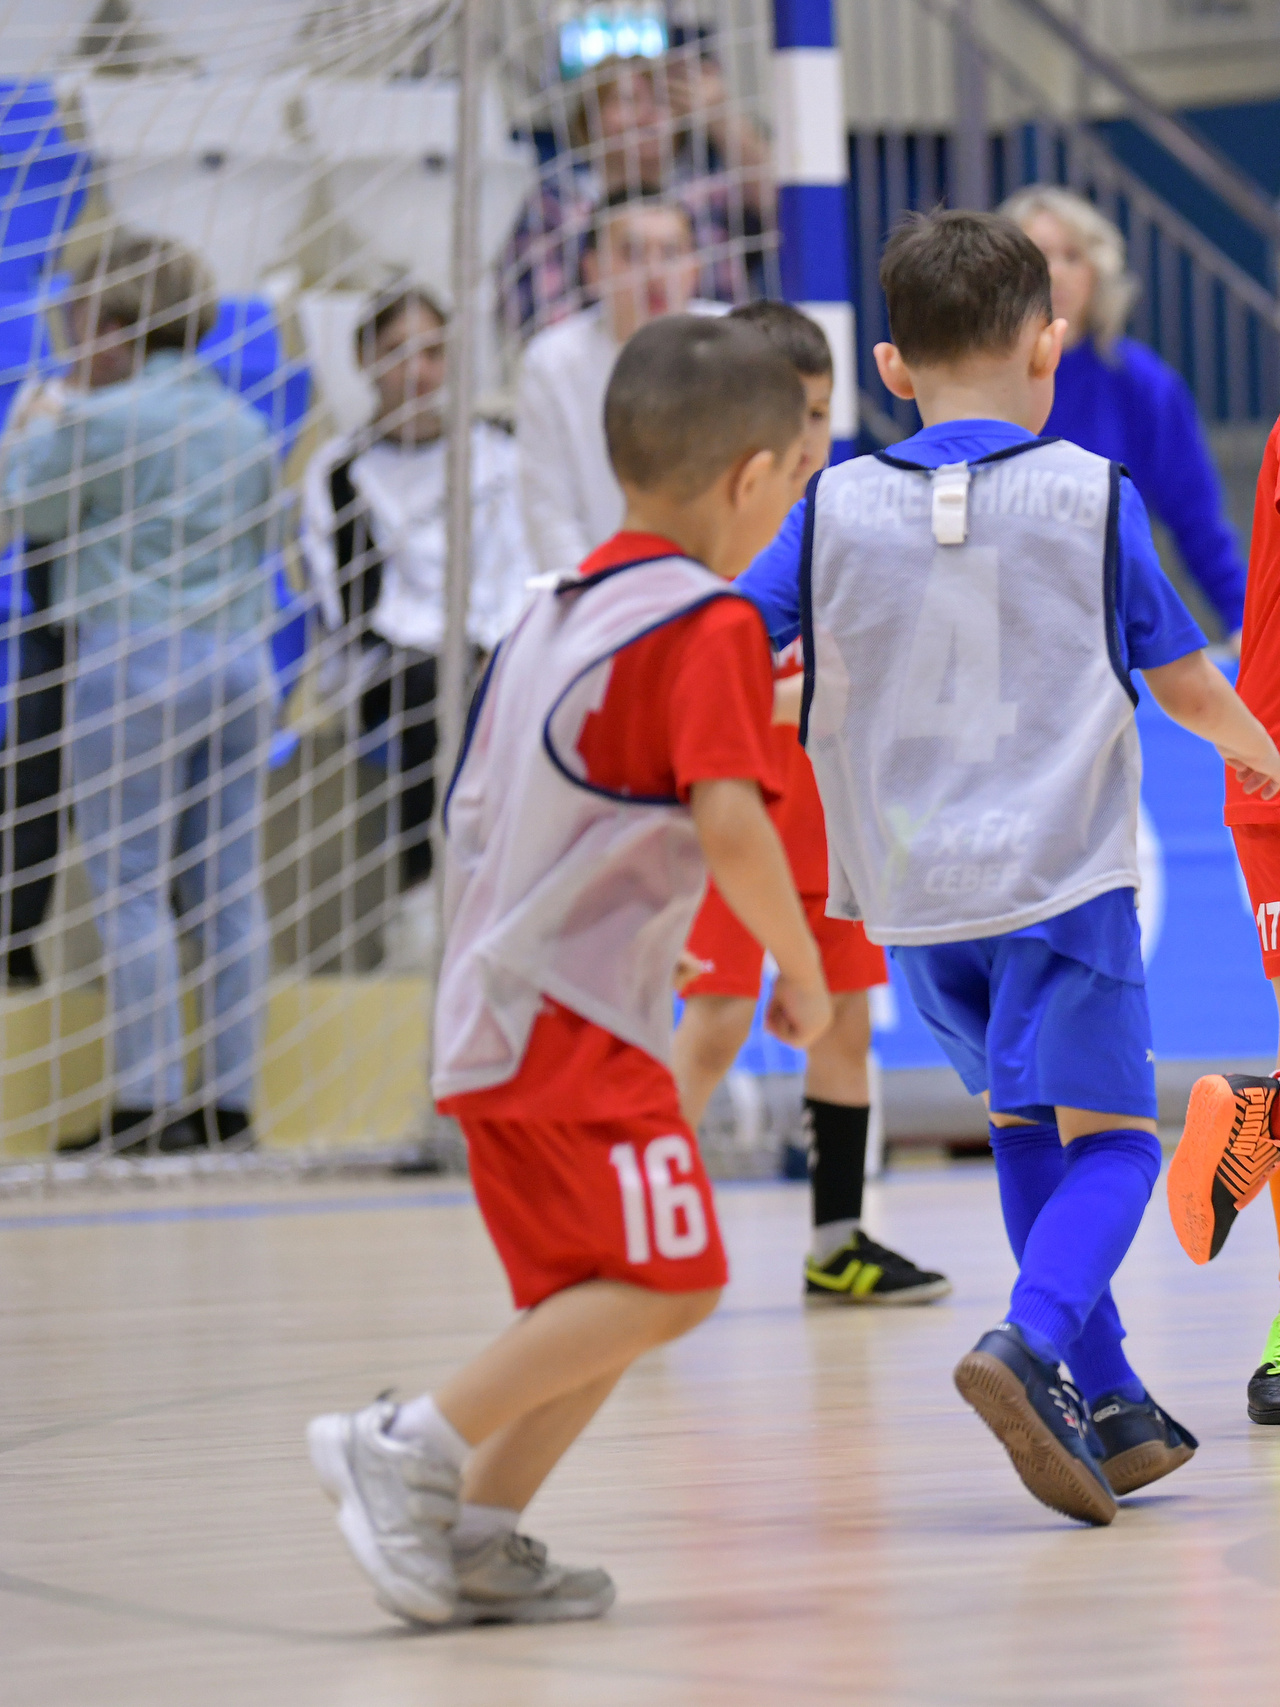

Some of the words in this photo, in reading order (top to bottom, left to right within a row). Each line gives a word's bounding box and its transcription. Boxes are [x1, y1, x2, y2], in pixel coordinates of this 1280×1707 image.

[834, 464, 1104, 528] СЕДЕНИКОВ
[899, 545, 1018, 763] 4
[1256, 901, 1280, 951] 17
[1230, 1086, 1266, 1157] PUMA
[609, 1134, 709, 1265] 16
